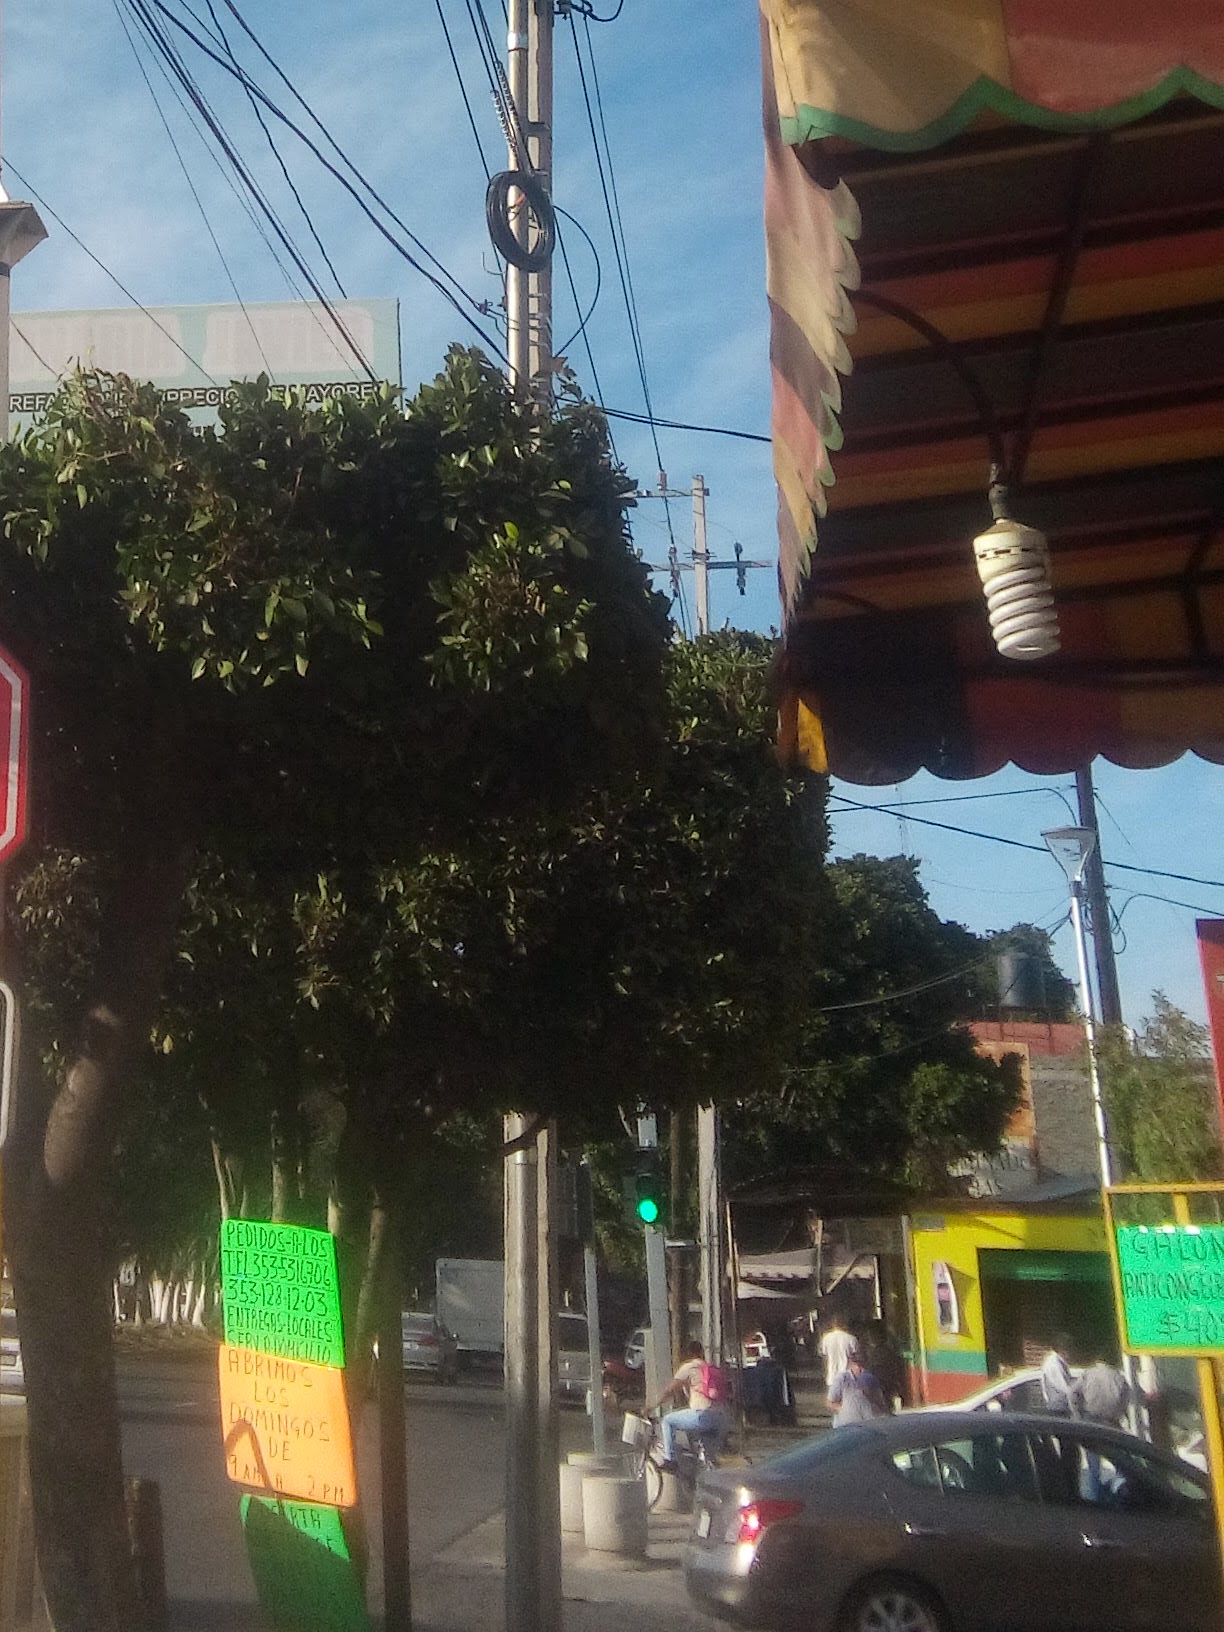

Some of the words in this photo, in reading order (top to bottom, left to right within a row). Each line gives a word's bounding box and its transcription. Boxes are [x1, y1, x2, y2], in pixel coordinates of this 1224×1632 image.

[228, 1349, 313, 1388] ABRIMOS
[254, 1380, 289, 1408] LOS
[229, 1401, 331, 1442] DOMINGOS
[268, 1435, 292, 1461] DE
